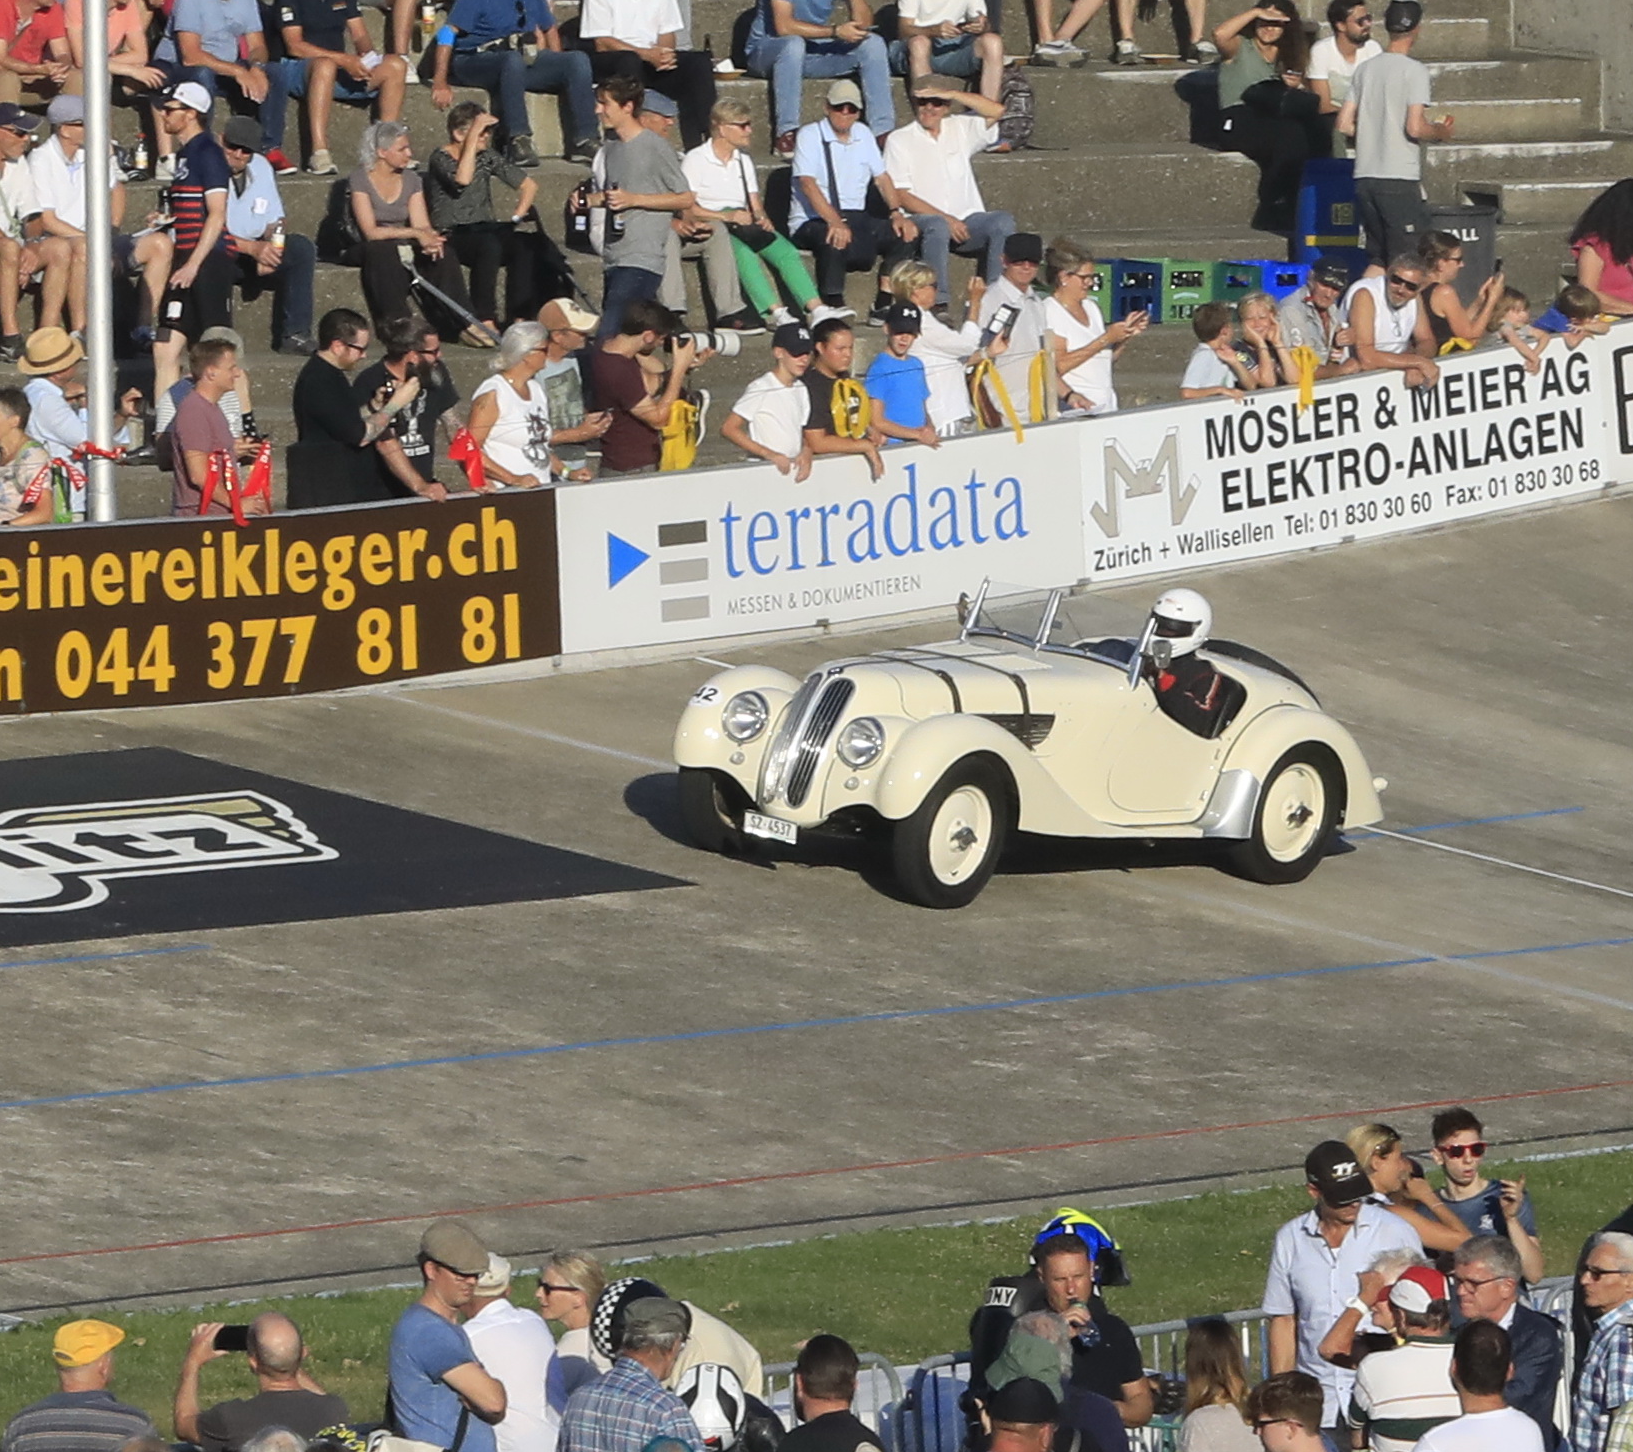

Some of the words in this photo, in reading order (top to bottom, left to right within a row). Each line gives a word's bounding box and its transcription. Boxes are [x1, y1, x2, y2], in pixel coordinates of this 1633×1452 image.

[1204, 387, 1363, 460] MÖSLER
[1373, 382, 1398, 424] &
[1407, 369, 1529, 424] MEIER
[1538, 352, 1590, 399] AG
[1221, 408, 1585, 513] ELEKTRO-ANLAGEN
[721, 462, 1030, 579] terradata
[1093, 540, 1154, 574] Zürich
[1178, 523, 1275, 562] Wallisellen
[1284, 513, 1312, 537] Tel:
[1319, 508, 1340, 532] 01
[1345, 503, 1377, 527] 830
[1382, 497, 1404, 521] 30
[1410, 494, 1433, 517] 60
[1444, 482, 1483, 508] Fax:
[1487, 475, 1508, 497] 01
[1514, 470, 1545, 492] 830
[1551, 464, 1574, 486] 30
[1578, 460, 1600, 484] 68
[56, 626, 176, 699] 044
[207, 616, 317, 690] 377
[358, 605, 418, 676] 81
[462, 594, 520, 664] 81
[727, 597, 785, 618] MESSEN
[788, 594, 799, 612] &
[801, 575, 922, 611] DOKUMENTIEREN
